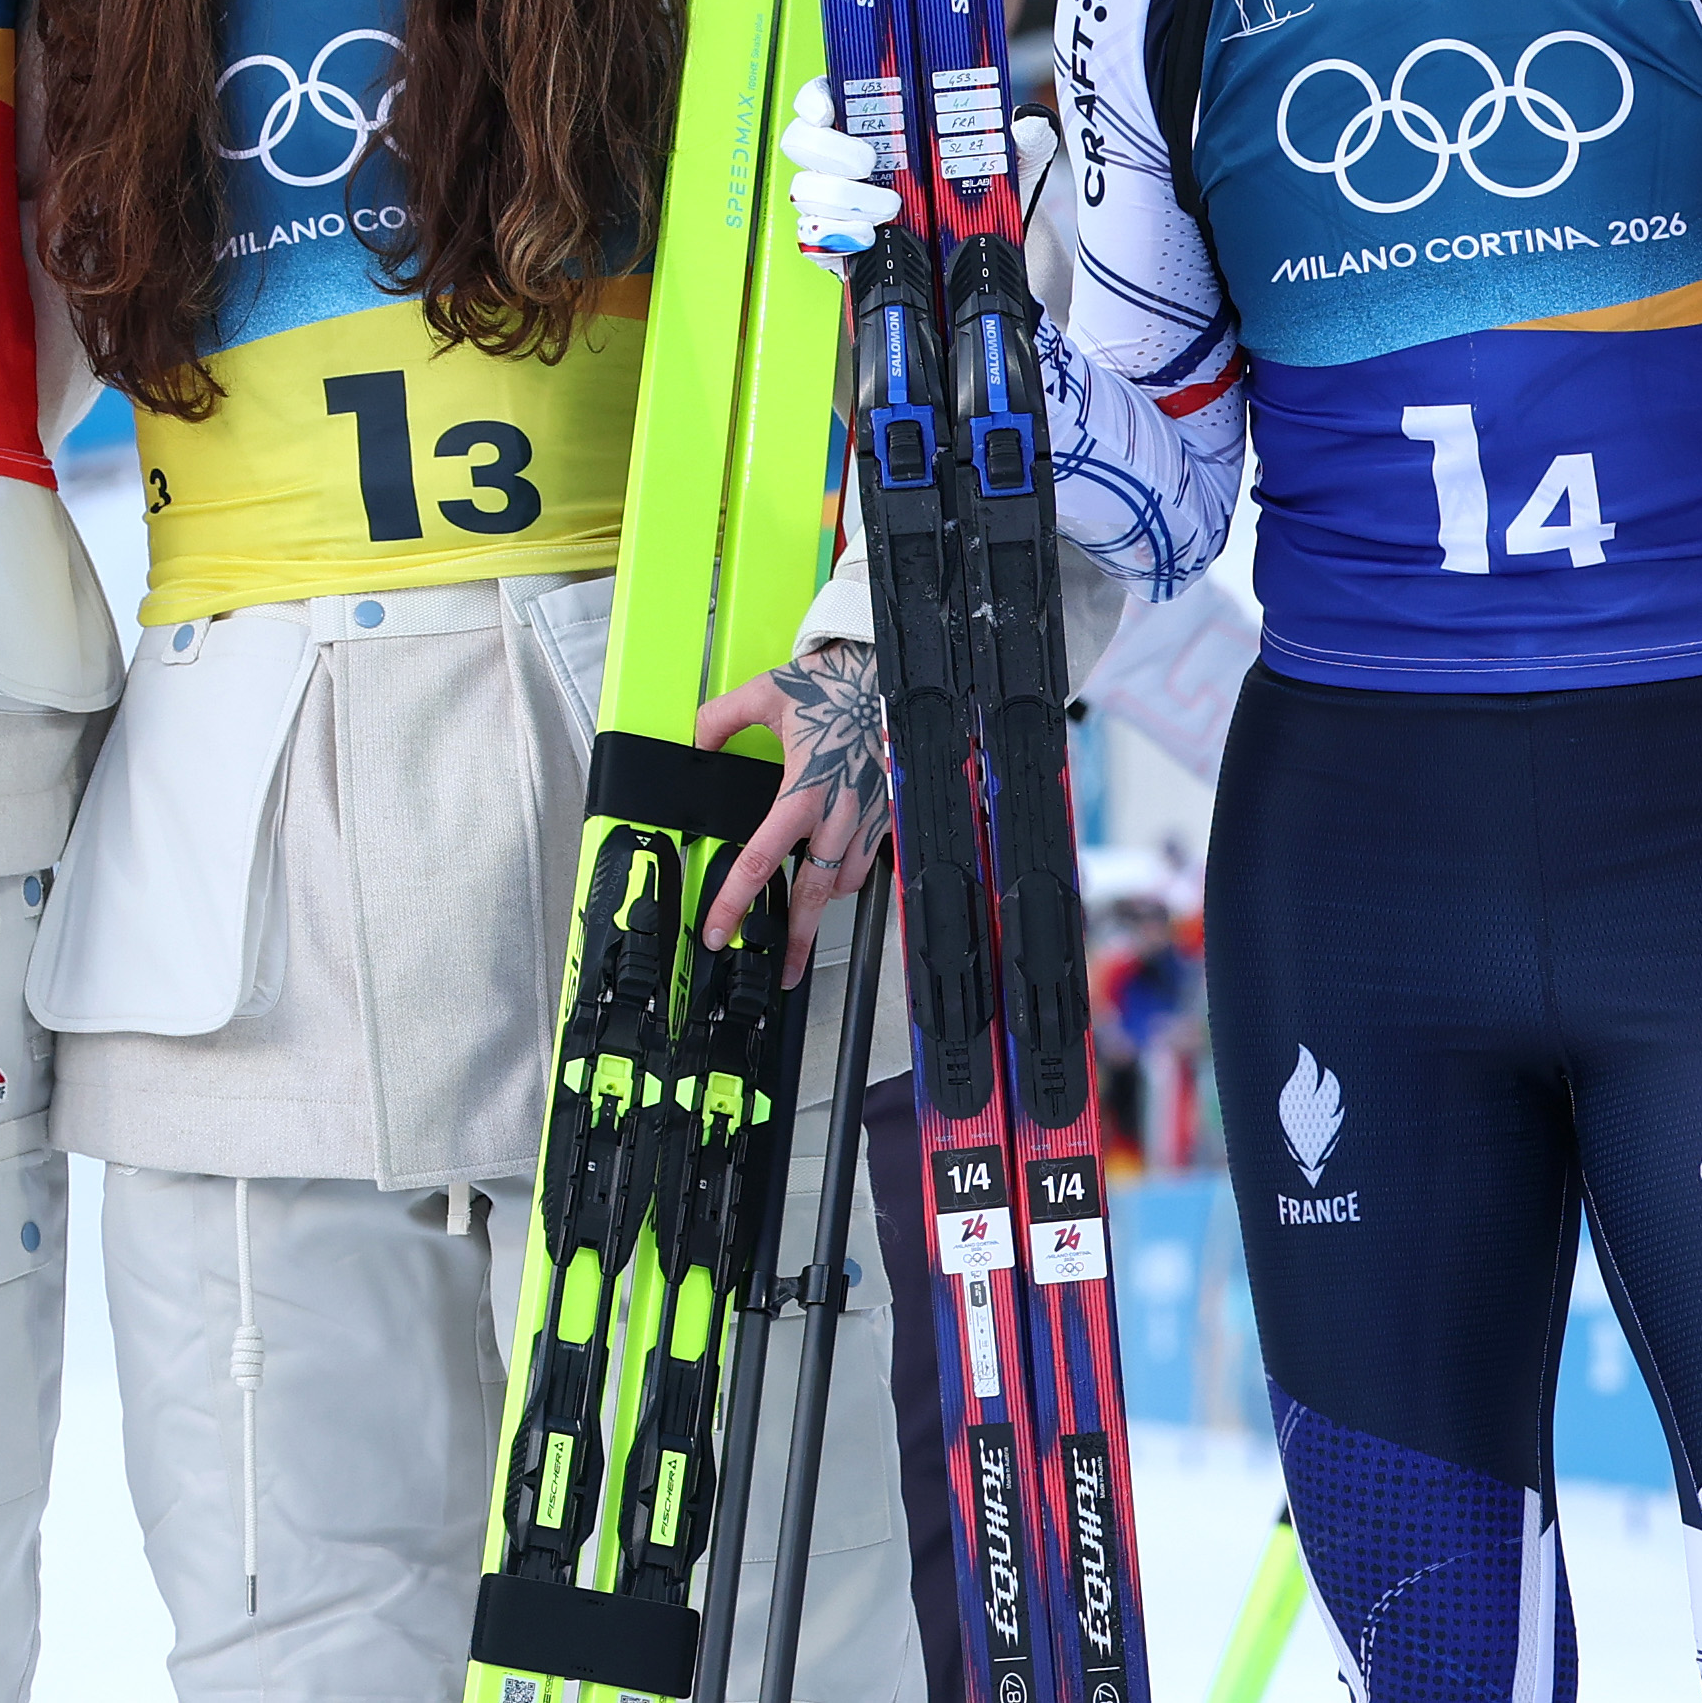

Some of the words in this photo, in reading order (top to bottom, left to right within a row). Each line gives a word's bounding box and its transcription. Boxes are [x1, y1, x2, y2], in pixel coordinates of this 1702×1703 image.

[861, 118, 886, 130] FRA
[952, 118, 976, 129] FRA
[1073, 14, 1106, 208] CRAFT
[1271, 242, 1417, 283] MILANO
[1425, 226, 1600, 264] CORTINA
[1608, 212, 1687, 246] 2026
[890, 310, 900, 378] SALOMON
[989, 318, 999, 386] SALOMON
[947, 1163, 992, 1194] 1/4
[1041, 1172, 1085, 1204] 1/4
[1278, 1191, 1361, 1225] FRANCE
[546, 1453, 563, 1520] FISCHER
[659, 1472, 677, 1539] FISCHER
